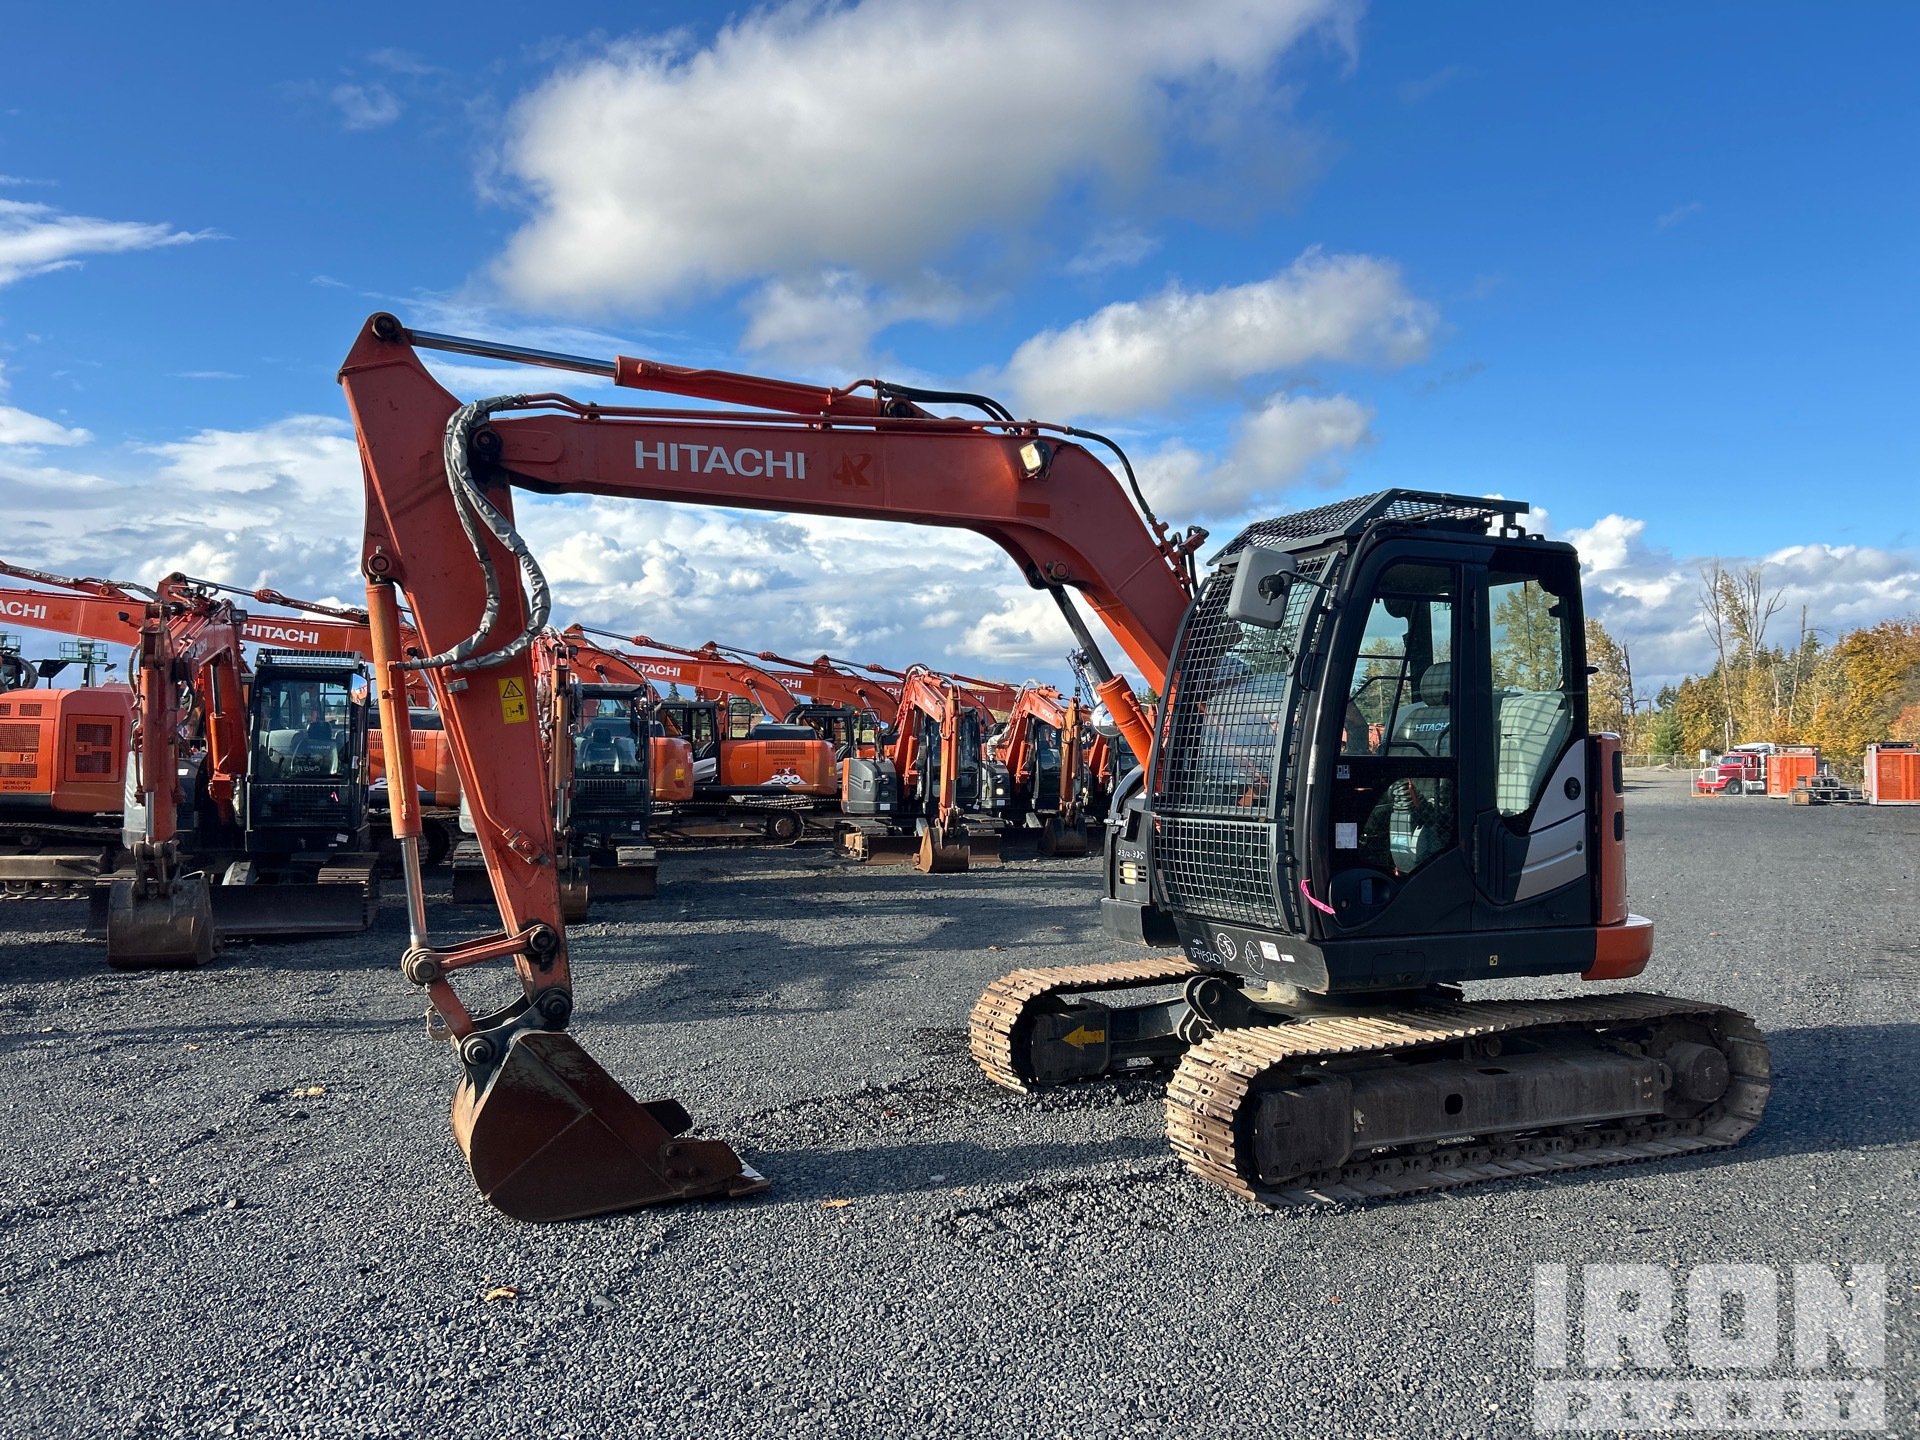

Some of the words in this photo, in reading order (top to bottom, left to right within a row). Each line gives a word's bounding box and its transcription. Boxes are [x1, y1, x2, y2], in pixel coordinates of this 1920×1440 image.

[634, 440, 806, 480] HITACHI
[241, 623, 319, 644] HITACHI
[771, 775, 801, 784] 200
